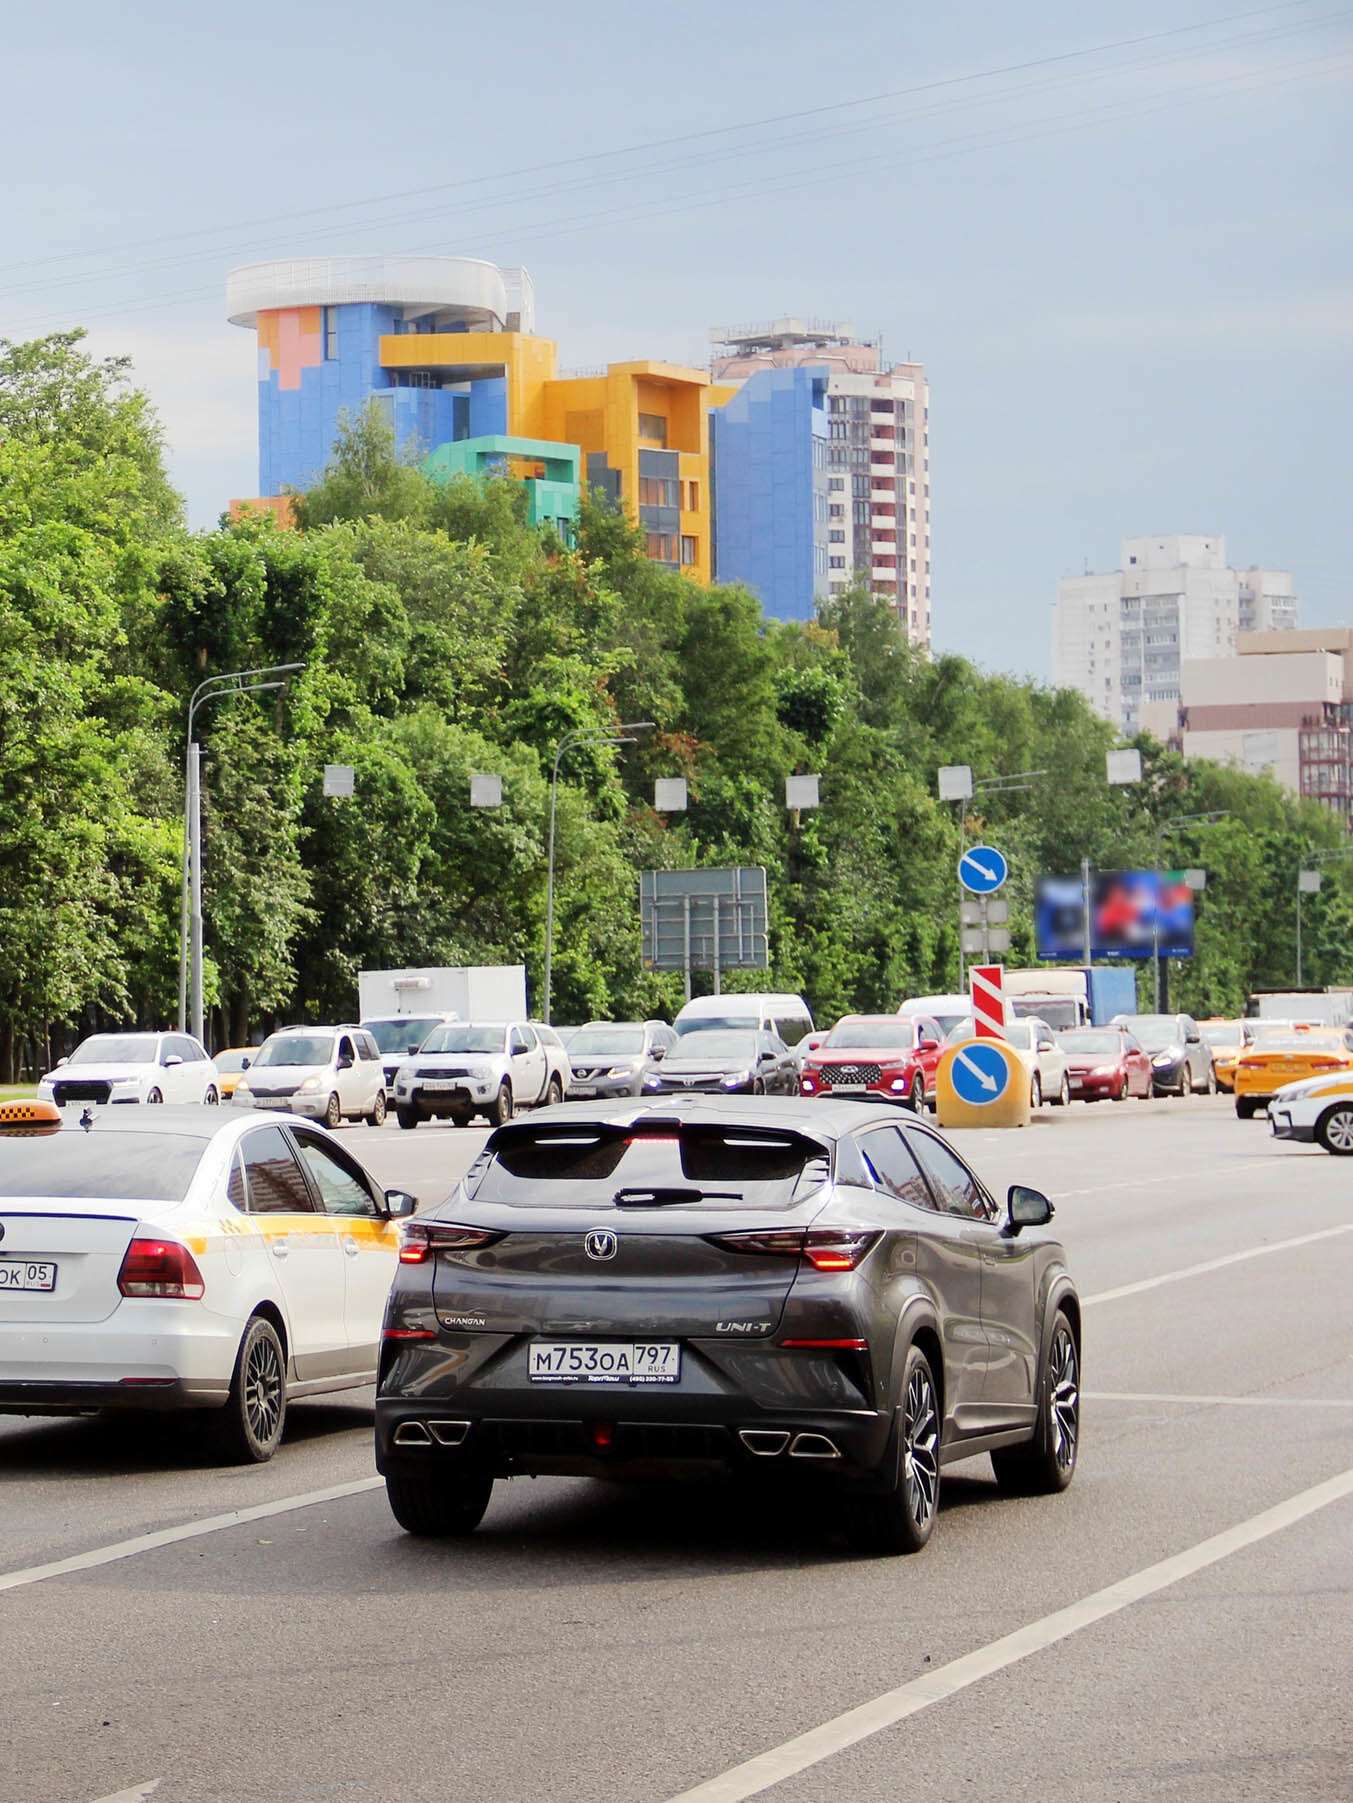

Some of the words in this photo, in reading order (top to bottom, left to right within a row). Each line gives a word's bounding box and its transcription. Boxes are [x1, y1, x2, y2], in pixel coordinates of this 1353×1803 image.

[27, 1265, 48, 1280] 05
[444, 1317, 487, 1326] CHANGAN
[715, 1322, 772, 1332] UNI-T
[536, 1347, 630, 1371] М753ОА
[635, 1346, 672, 1364] 797
[647, 1365, 666, 1373] RUS
